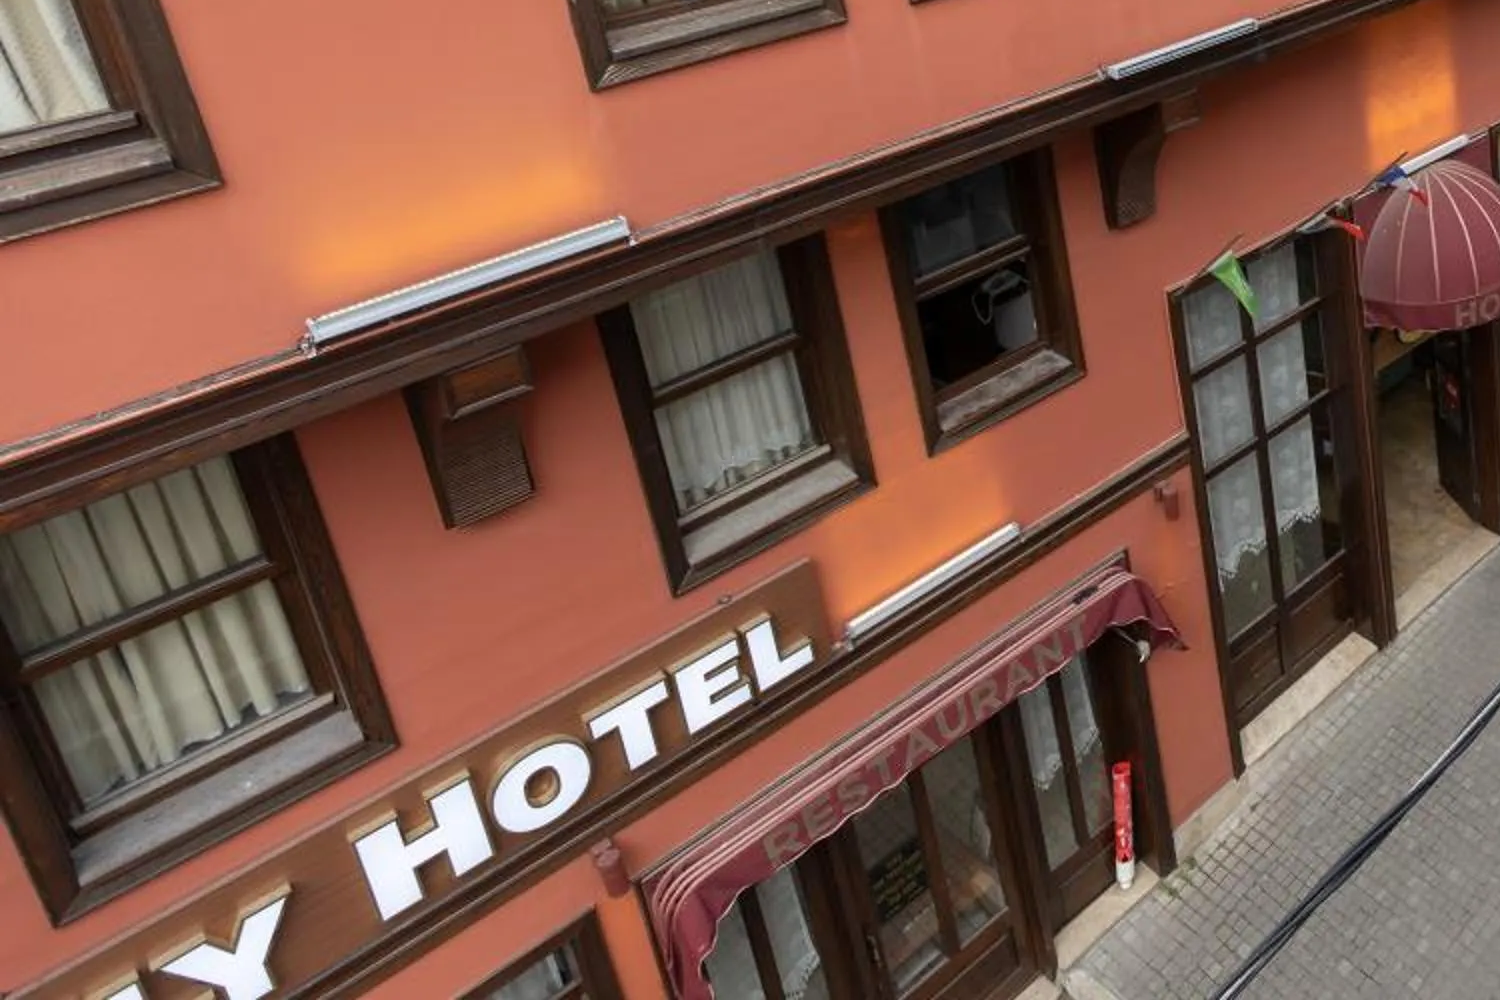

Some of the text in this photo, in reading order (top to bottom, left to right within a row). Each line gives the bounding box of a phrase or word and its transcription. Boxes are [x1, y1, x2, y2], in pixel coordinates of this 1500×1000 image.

[102, 612, 816, 1000] Y HOTEL
[761, 614, 1088, 869] RESTAURANT
